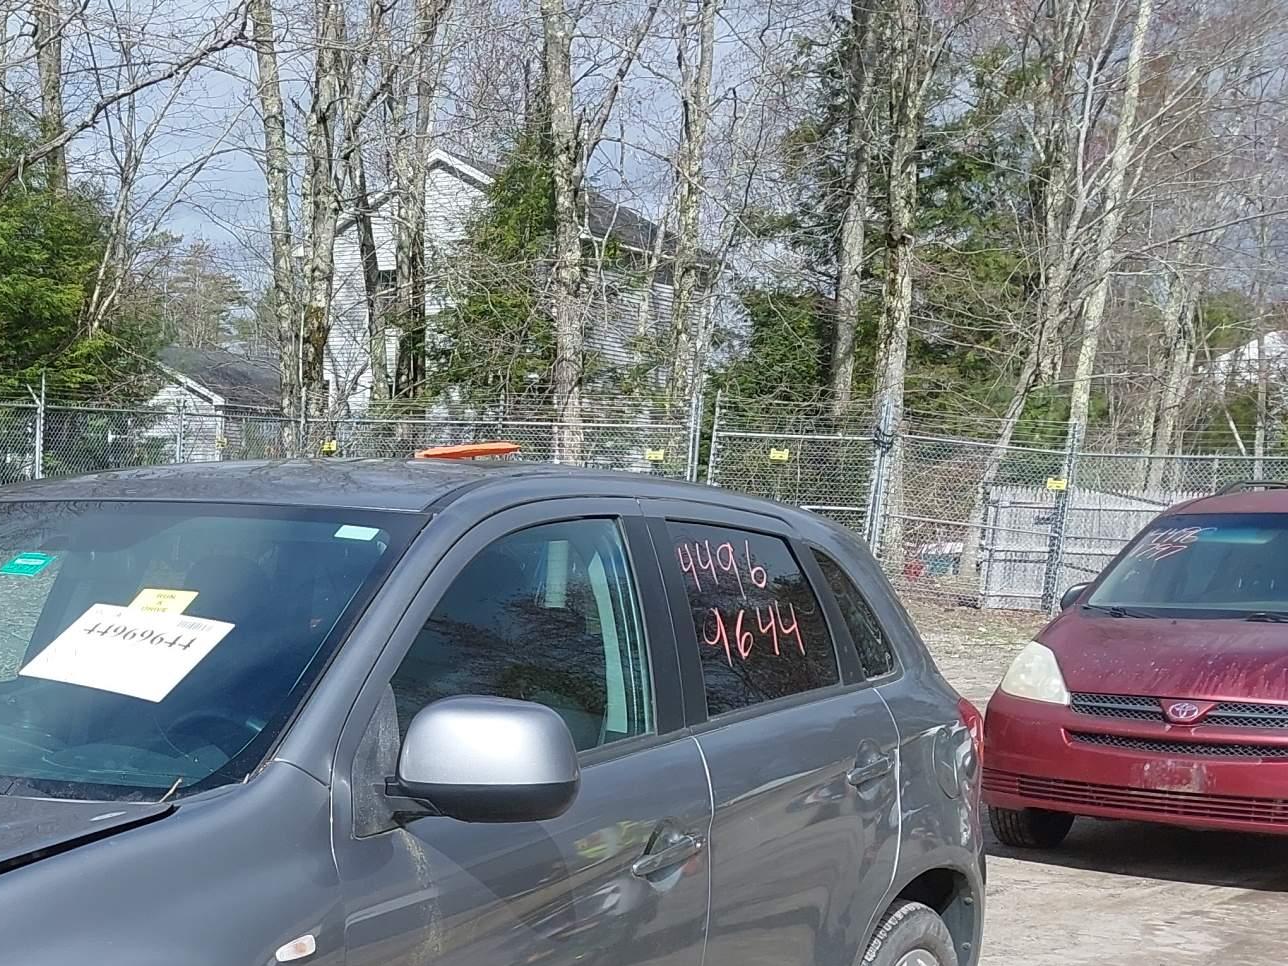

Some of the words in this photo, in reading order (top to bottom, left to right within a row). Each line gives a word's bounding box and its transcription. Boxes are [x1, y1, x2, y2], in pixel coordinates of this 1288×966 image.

[678, 539, 767, 600] 4496
[83, 622, 197, 651] 44969644
[703, 600, 806, 667] 9644
